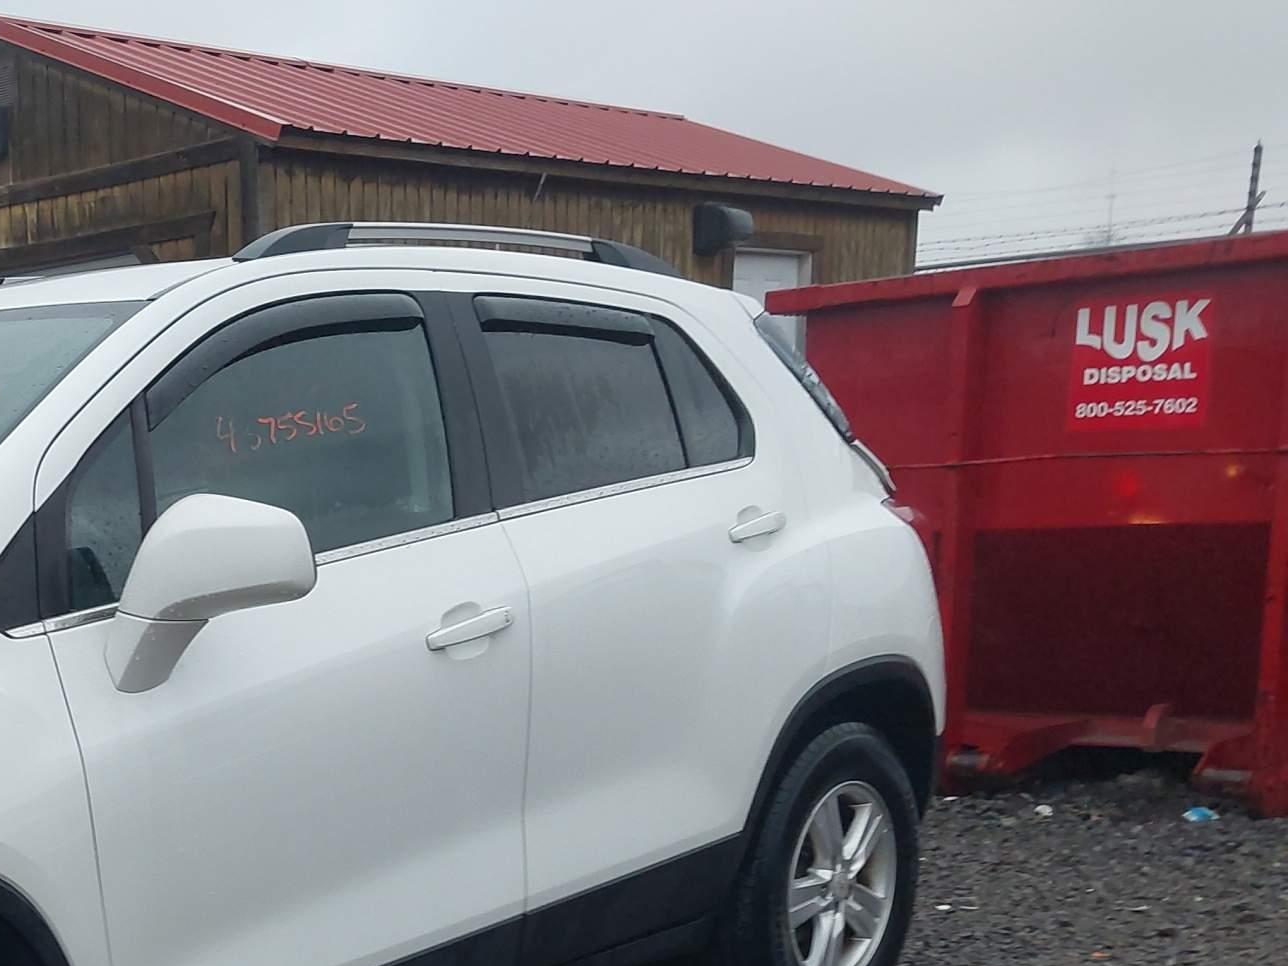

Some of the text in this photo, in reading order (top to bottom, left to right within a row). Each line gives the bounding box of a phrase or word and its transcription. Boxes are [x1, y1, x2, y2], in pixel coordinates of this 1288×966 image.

[1075, 298, 1211, 362] LUSK
[1083, 362, 1197, 385] DISPOSAL
[1074, 397, 1199, 419] 800-525-7602
